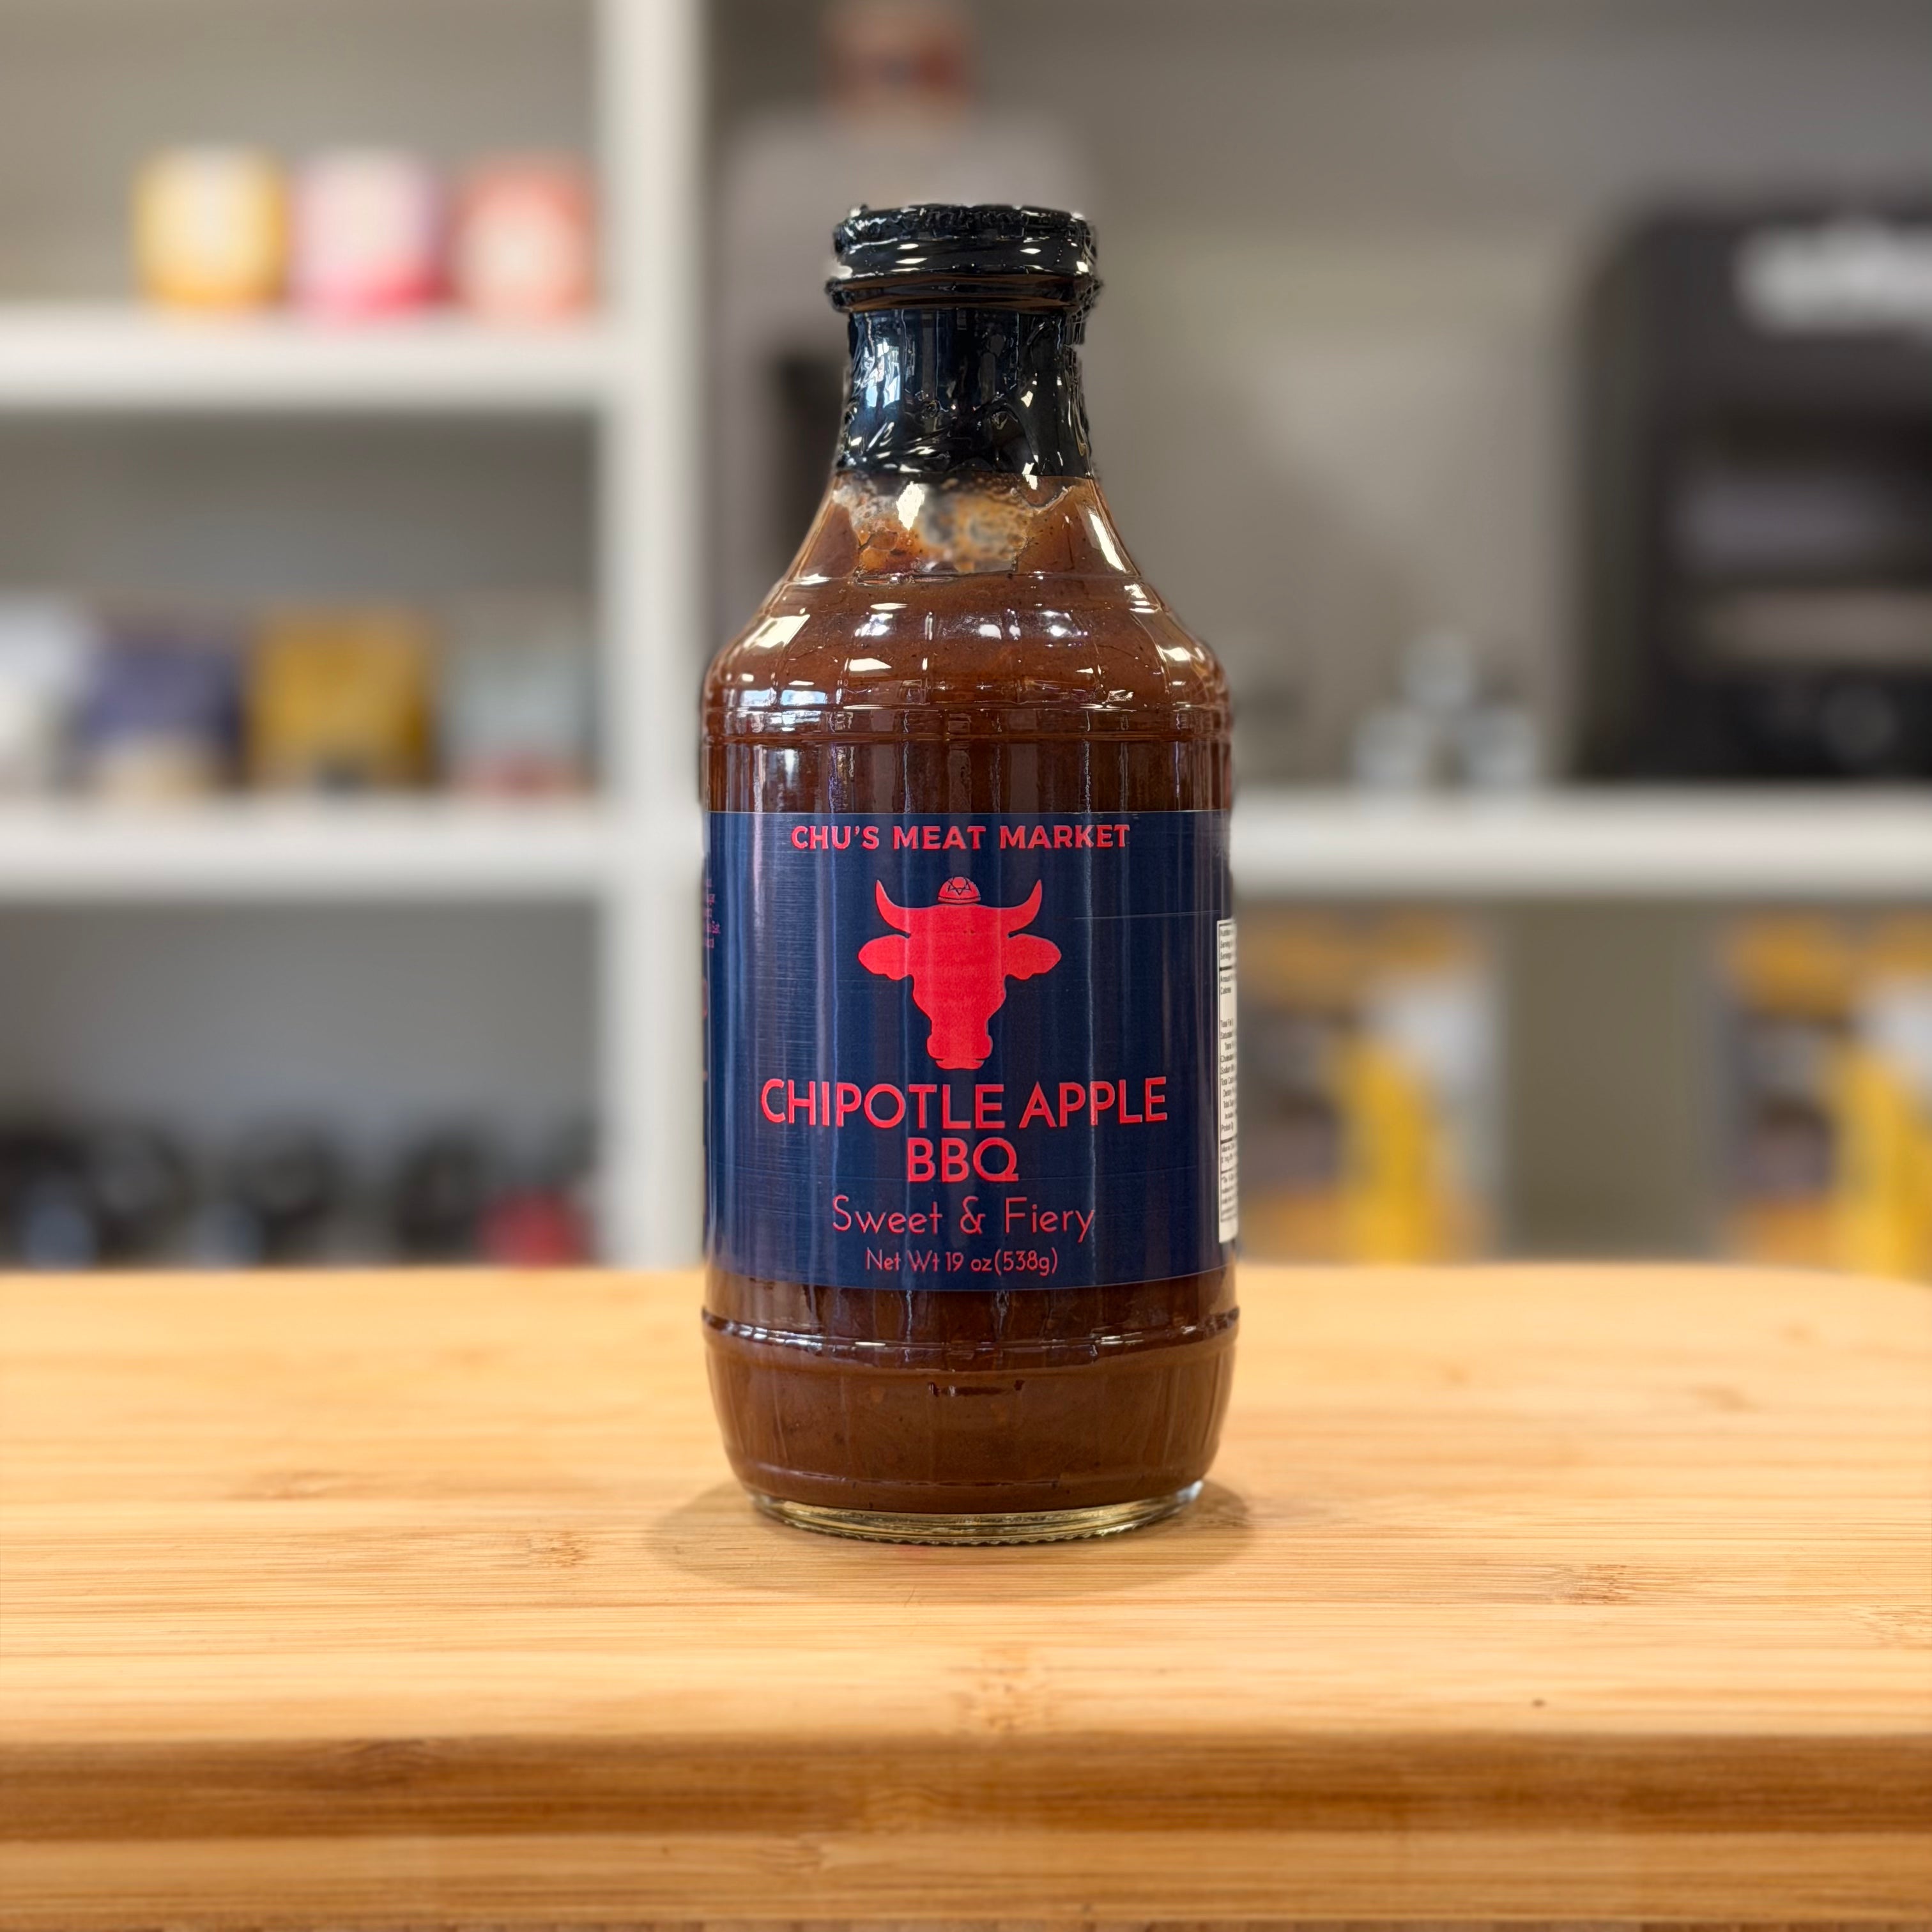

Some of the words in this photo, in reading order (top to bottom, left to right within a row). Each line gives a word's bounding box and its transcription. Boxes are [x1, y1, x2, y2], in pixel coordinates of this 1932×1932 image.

[790, 825, 880, 851] CHU'S
[893, 825, 986, 851] MEAT
[999, 824, 1130, 851] MARKET
[761, 1078, 1006, 1130] CHIPOTLE
[1018, 1076, 1168, 1129] APPLE
[906, 1137, 1020, 1184] BBQ
[832, 1195, 942, 1235] Sweet
[959, 1196, 985, 1235] &
[1004, 1196, 1095, 1244] Fiery
[866, 1248, 901, 1271] Net
[906, 1249, 940, 1272] Wt
[945, 1252, 964, 1272] 19
